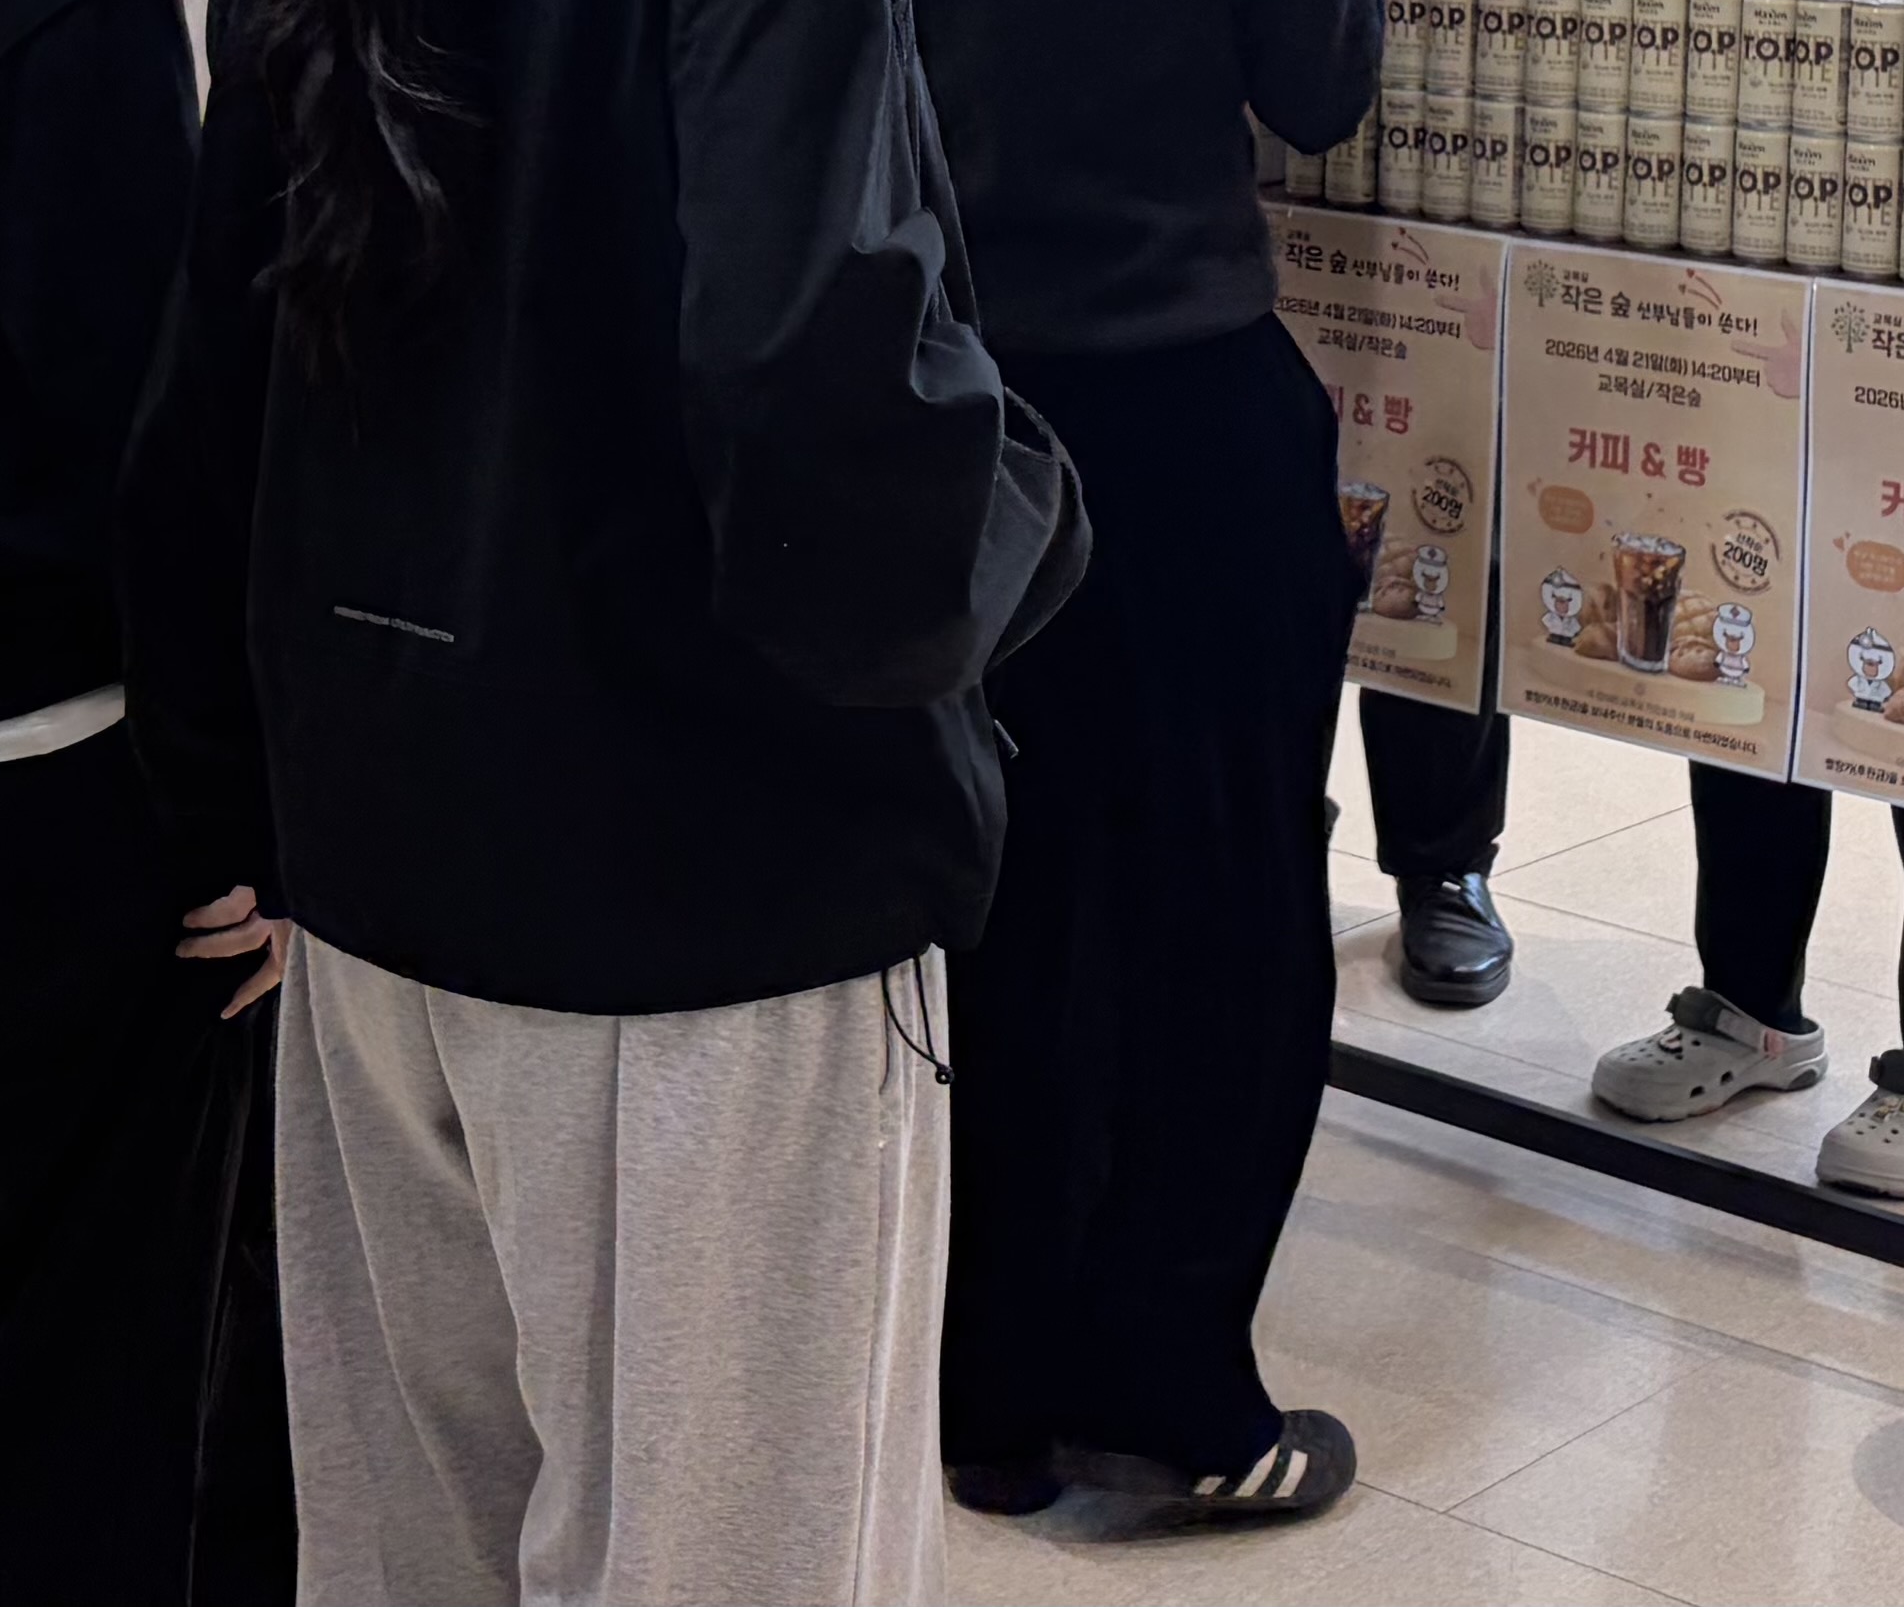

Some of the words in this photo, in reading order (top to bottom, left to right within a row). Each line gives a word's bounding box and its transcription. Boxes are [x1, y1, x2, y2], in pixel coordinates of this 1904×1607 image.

[1285, 244, 1324, 272] 작은
[1329, 250, 1347, 275] 숲
[1352, 260, 1420, 286] 신부님들이
[1322, 303, 1345, 320] 4월
[1561, 284, 1603, 316] 작은
[1611, 291, 1632, 318] 숲
[1637, 302, 1713, 329] 신부님들이
[1545, 338, 1600, 363] 2026년
[1603, 349, 1629, 368] 4월
[1632, 351, 1688, 376] 21일(화)
[1691, 360, 1761, 388] 14:20부터
[1597, 373, 1702, 408] 교목실/작은숲
[1384, 395, 1414, 435] 빵
[1568, 427, 1631, 475] 커피
[1640, 442, 1667, 480] &
[1676, 444, 1710, 488] 빵
[1723, 541, 1769, 577] 200명
